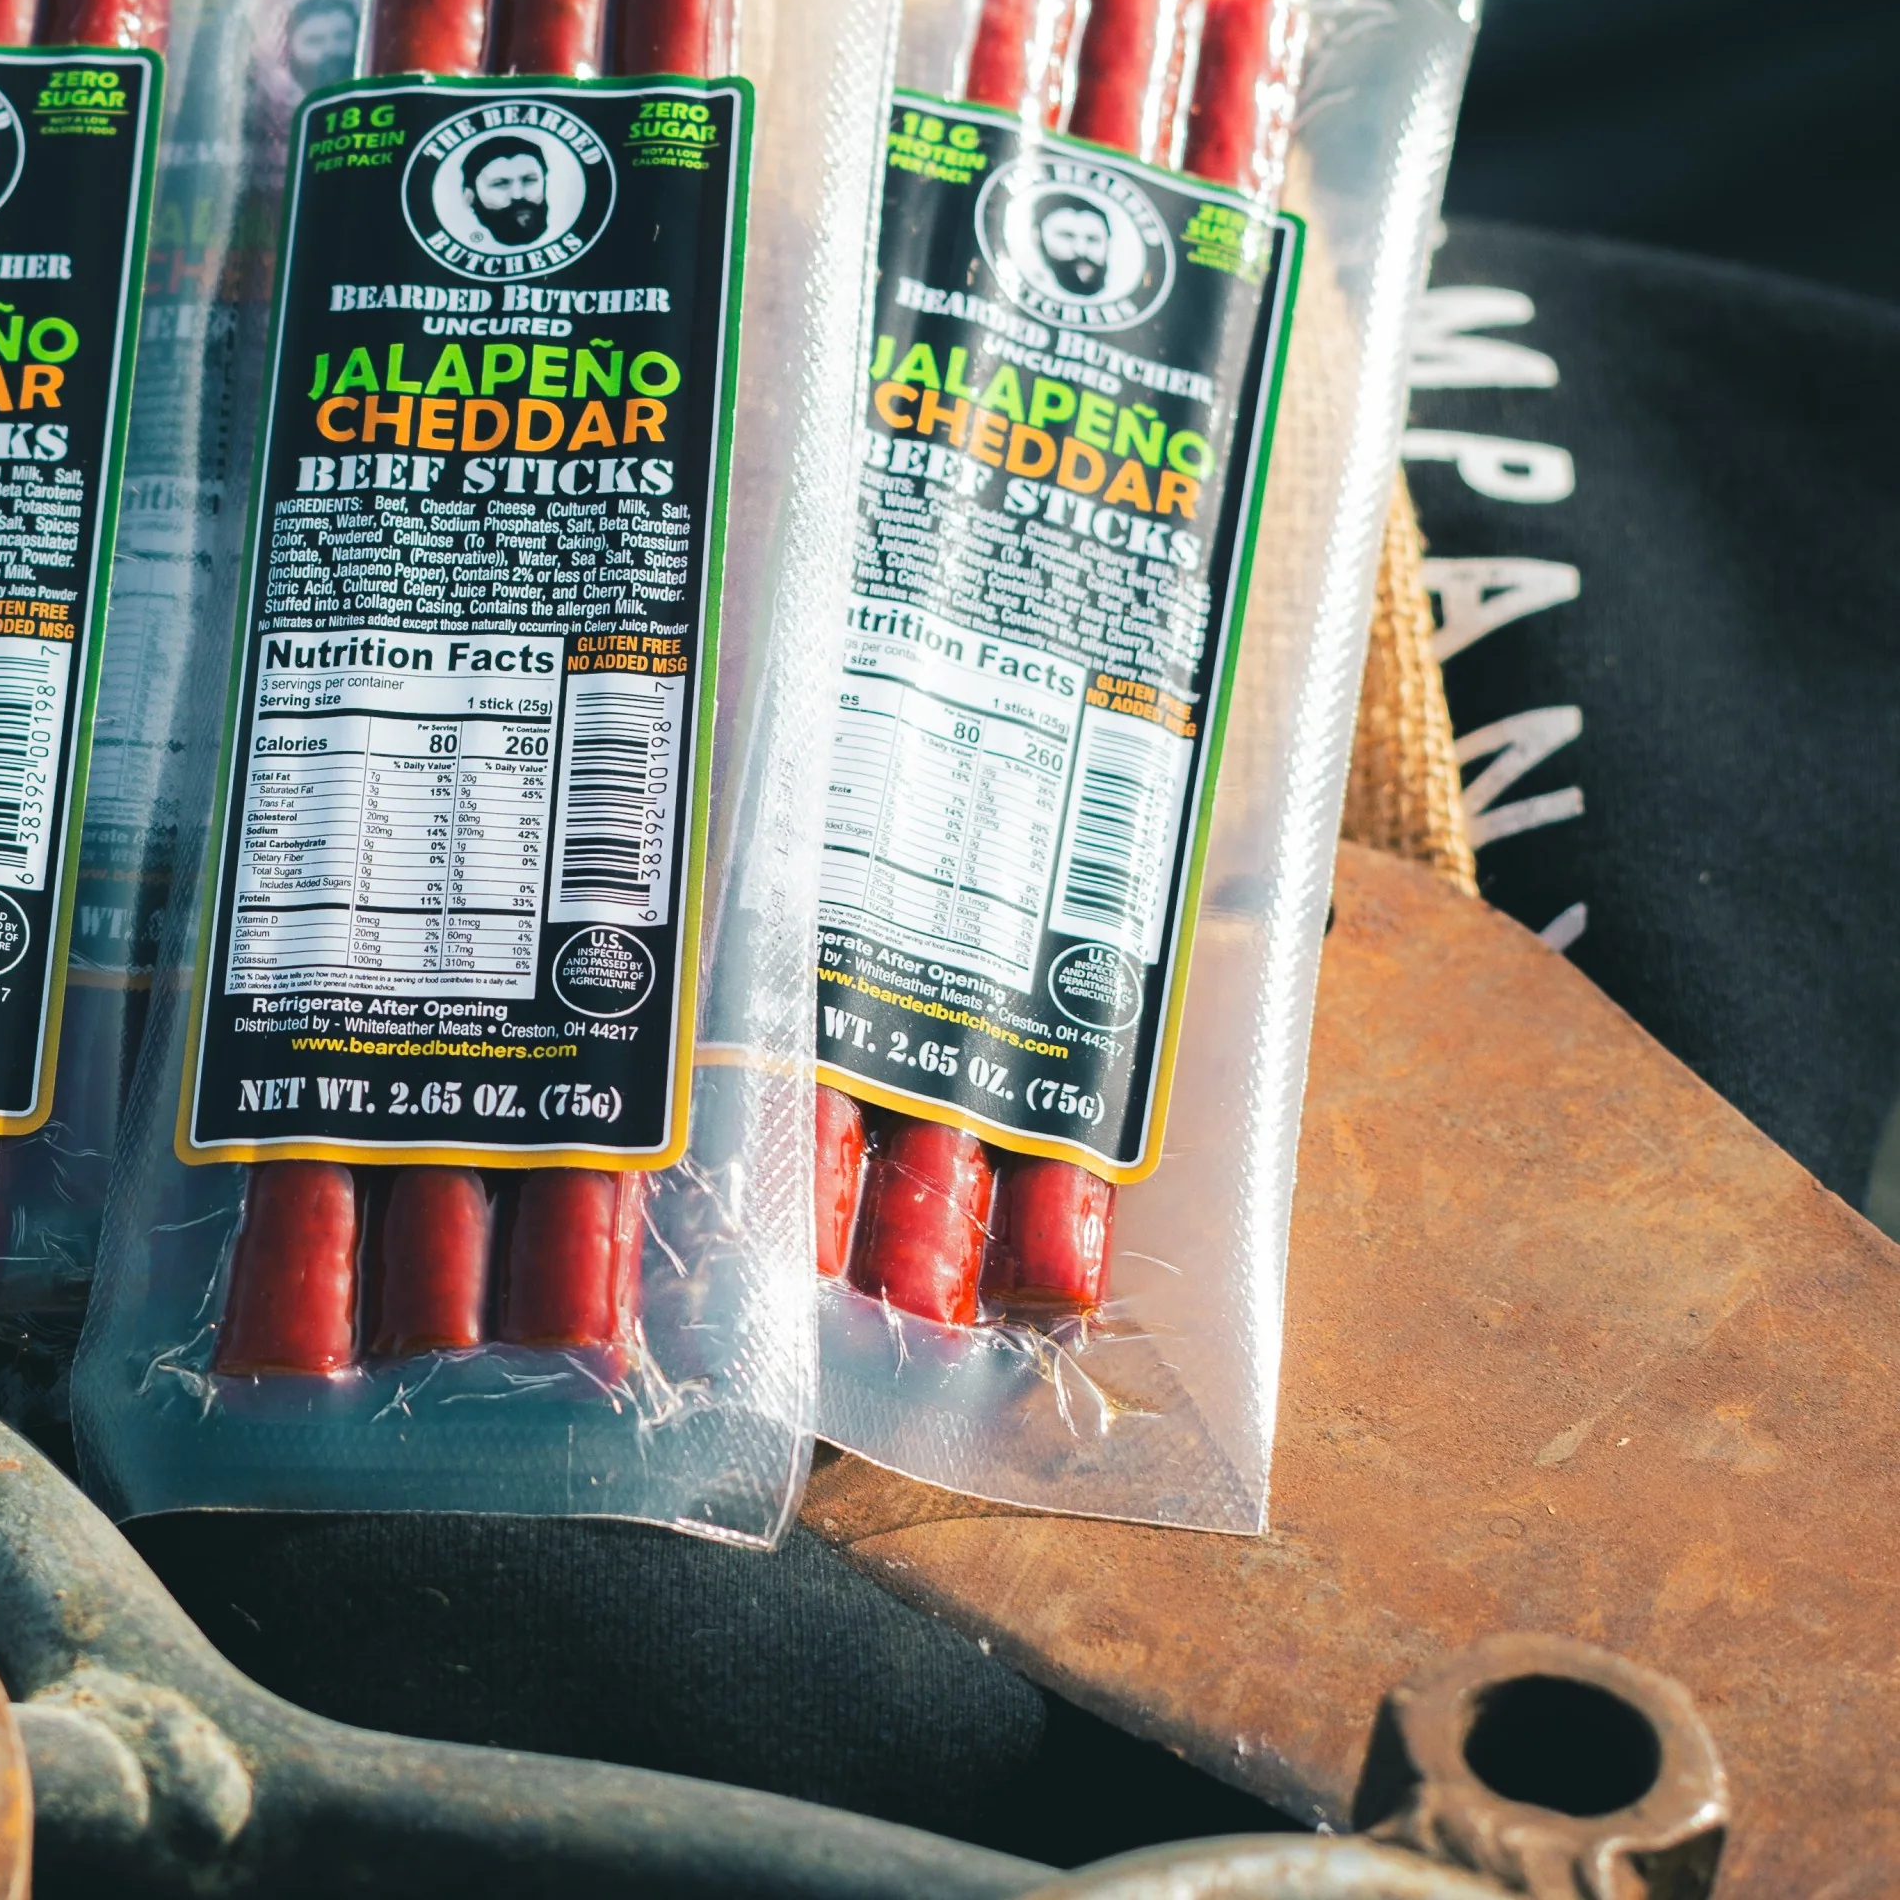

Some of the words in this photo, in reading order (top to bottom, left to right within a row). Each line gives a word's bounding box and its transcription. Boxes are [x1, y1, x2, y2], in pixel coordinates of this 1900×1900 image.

[49, 71, 119, 88] ZERO
[38, 90, 126, 107] SUGAR
[325, 107, 361, 133] 18
[370, 105, 395, 127] G
[639, 102, 709, 122] ZERO
[424, 119, 474, 160] THE
[482, 107, 603, 168] BEARDED
[629, 121, 717, 142] SUGAR
[308, 130, 405, 159] PROTEIN
[642, 148, 664, 156] NOT
[666, 149, 674, 157] A
[676, 149, 702, 159] LOW
[315, 157, 343, 173] PER
[347, 152, 393, 167] PACK
[632, 158, 676, 166] CALORIE
[679, 159, 709, 169] FOOD
[426, 233, 584, 274] BUTCHERS
[422, 317, 572, 337] UNCURED
[308, 339, 681, 401] JALAPEÑO
[982, 336, 1122, 395] UNCURED
[870, 335, 1215, 478] JALAPEÑO
[316, 396, 667, 452] CHEDDAR
[874, 380, 1201, 519] CHEDDAR
[296, 455, 445, 492] BEEF
[463, 457, 674, 495] STICKS
[275, 497, 363, 516] INGREDIENTS:
[375, 495, 409, 514] Beef,
[421, 499, 476, 515] Cheddar
[487, 501, 536, 516] Cheese
[547, 501, 606, 519] (Cultured
[618, 499, 650, 517] Milk,
[662, 503, 691, 520] Salt,
[865, 428, 993, 496] BEEF
[1004, 478, 1202, 570] STICKS
[274, 517, 332, 532] Enzymes,
[336, 515, 377, 528] Water,
[380, 512, 427, 531] Cream,
[430, 516, 480, 531] Sodium
[484, 517, 563, 535] Phosphates,
[567, 520, 595, 534] Salt,
[600, 517, 628, 532] Beta
[631, 516, 690, 535] Carotene
[30, 603, 69, 620] FREE
[40, 622, 74, 640] MSG
[266, 637, 432, 670] Nutrition
[448, 643, 554, 673] Facts
[577, 636, 637, 652] GLUTEN
[643, 638, 681, 654] FREE
[568, 656, 589, 671] NO
[594, 655, 648, 671] ADDED
[652, 657, 688, 673] MSG
[977, 644, 1075, 697] Facts
[261, 679, 268, 690] 3
[272, 678, 322, 693] servings
[325, 678, 344, 690] per
[347, 677, 404, 690] container
[260, 695, 310, 708] Serving
[315, 694, 341, 705] size
[468, 697, 474, 708] 1
[479, 698, 513, 710] stick
[518, 699, 553, 715] (25g)
[255, 736, 327, 751] Calories
[429, 734, 458, 753] 80
[505, 736, 549, 756] 260
[954, 722, 981, 744] 80
[1024, 742, 1063, 772] 260
[248, 813, 297, 822] Cholesterol
[246, 827, 278, 835] Sodium
[239, 894, 270, 903] Protein
[236, 929, 270, 938] Calcium
[591, 931, 623, 950] U.S.
[233, 956, 277, 965] Potassium
[578, 948, 632, 960] INSPECTED
[591, 959, 627, 969] PASSED
[630, 962, 643, 970] BY
[563, 967, 628, 979] DEPARTMENT
[630, 972, 644, 980] OF
[569, 977, 636, 990] AGRICULTURE
[876, 946, 924, 975] After
[928, 963, 1006, 1004] Opening
[824, 950, 843, 967] by
[854, 957, 940, 998] Whitefeather
[941, 987, 983, 1011] Meats
[998, 1007, 1052, 1038] Creston,
[1056, 1025, 1078, 1043] OH
[252, 998, 362, 1014] Refrigerate
[367, 1000, 419, 1016] After
[424, 1001, 507, 1021] Opening
[234, 1016, 308, 1034] Distributed
[313, 1017, 330, 1032] by
[344, 1017, 432, 1035] Whitefeather
[439, 1021, 482, 1036] Meats
[502, 1022, 559, 1039] Creston,
[564, 1022, 585, 1037] OH
[590, 1024, 638, 1041] 44217
[292, 1036, 578, 1059] www.beardedbutchers.com
[824, 1005, 876, 1053] WT.
[887, 1031, 960, 1077] 2.65
[968, 1056, 1015, 1100] OZ.
[238, 1077, 305, 1112] NET
[317, 1078, 375, 1113] WT.
[389, 1082, 462, 1115] 2.65
[473, 1084, 526, 1118] OZ.
